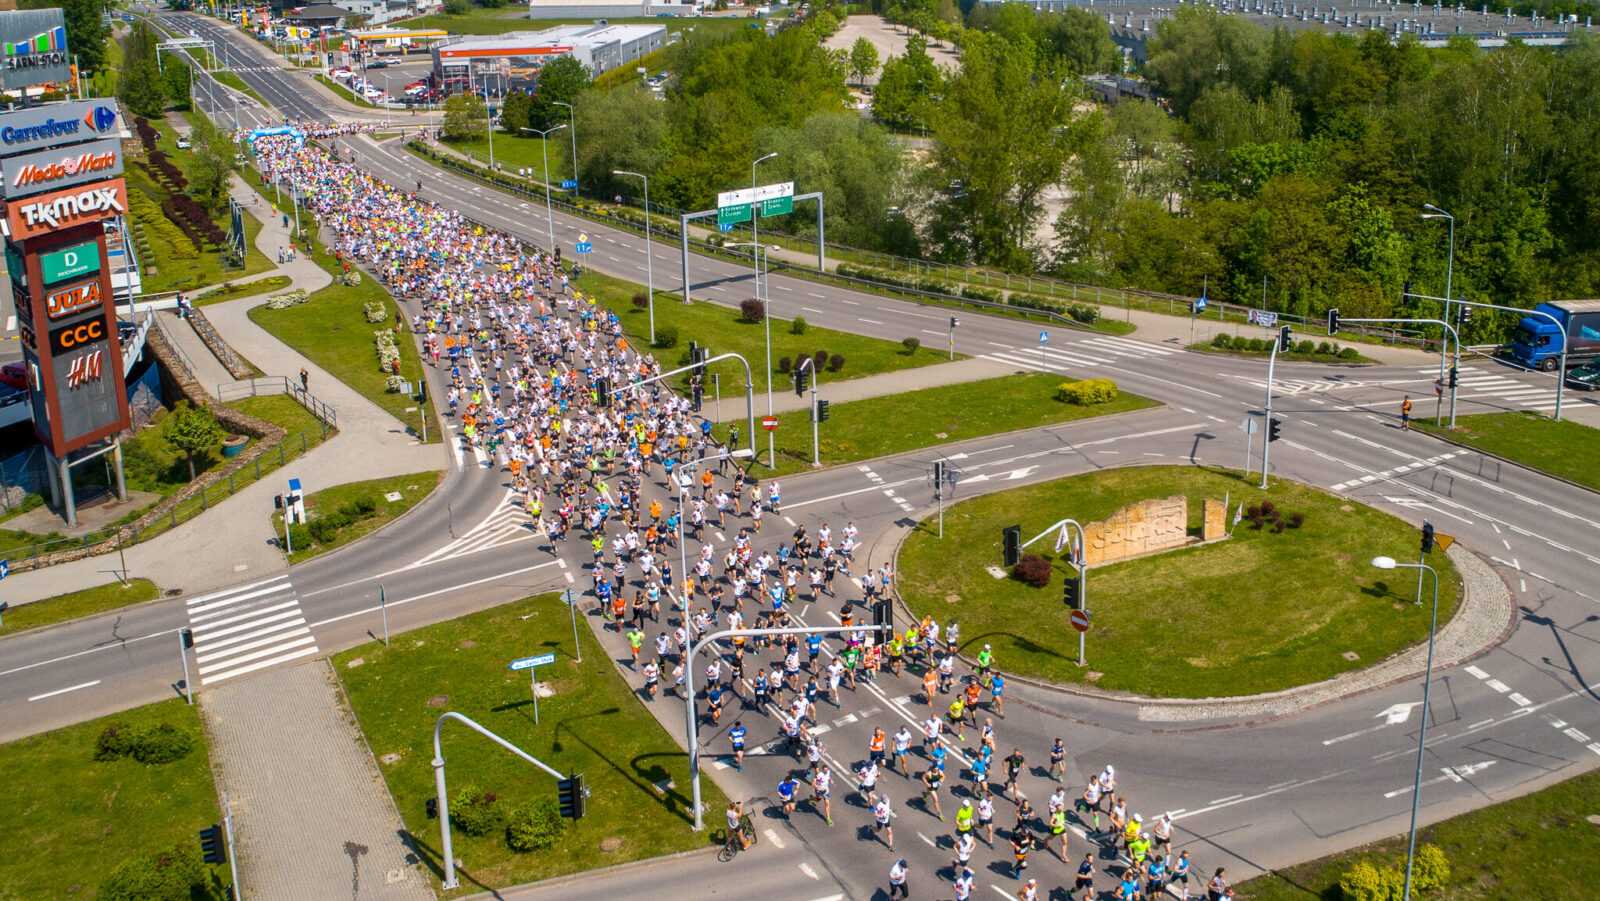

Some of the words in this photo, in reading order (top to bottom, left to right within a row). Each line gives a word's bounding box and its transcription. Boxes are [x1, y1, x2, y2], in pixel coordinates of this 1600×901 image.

[1, 119, 80, 144] Carrefour
[64, 252, 78, 267] D
[51, 285, 100, 312] JULA
[60, 321, 102, 348] CCC
